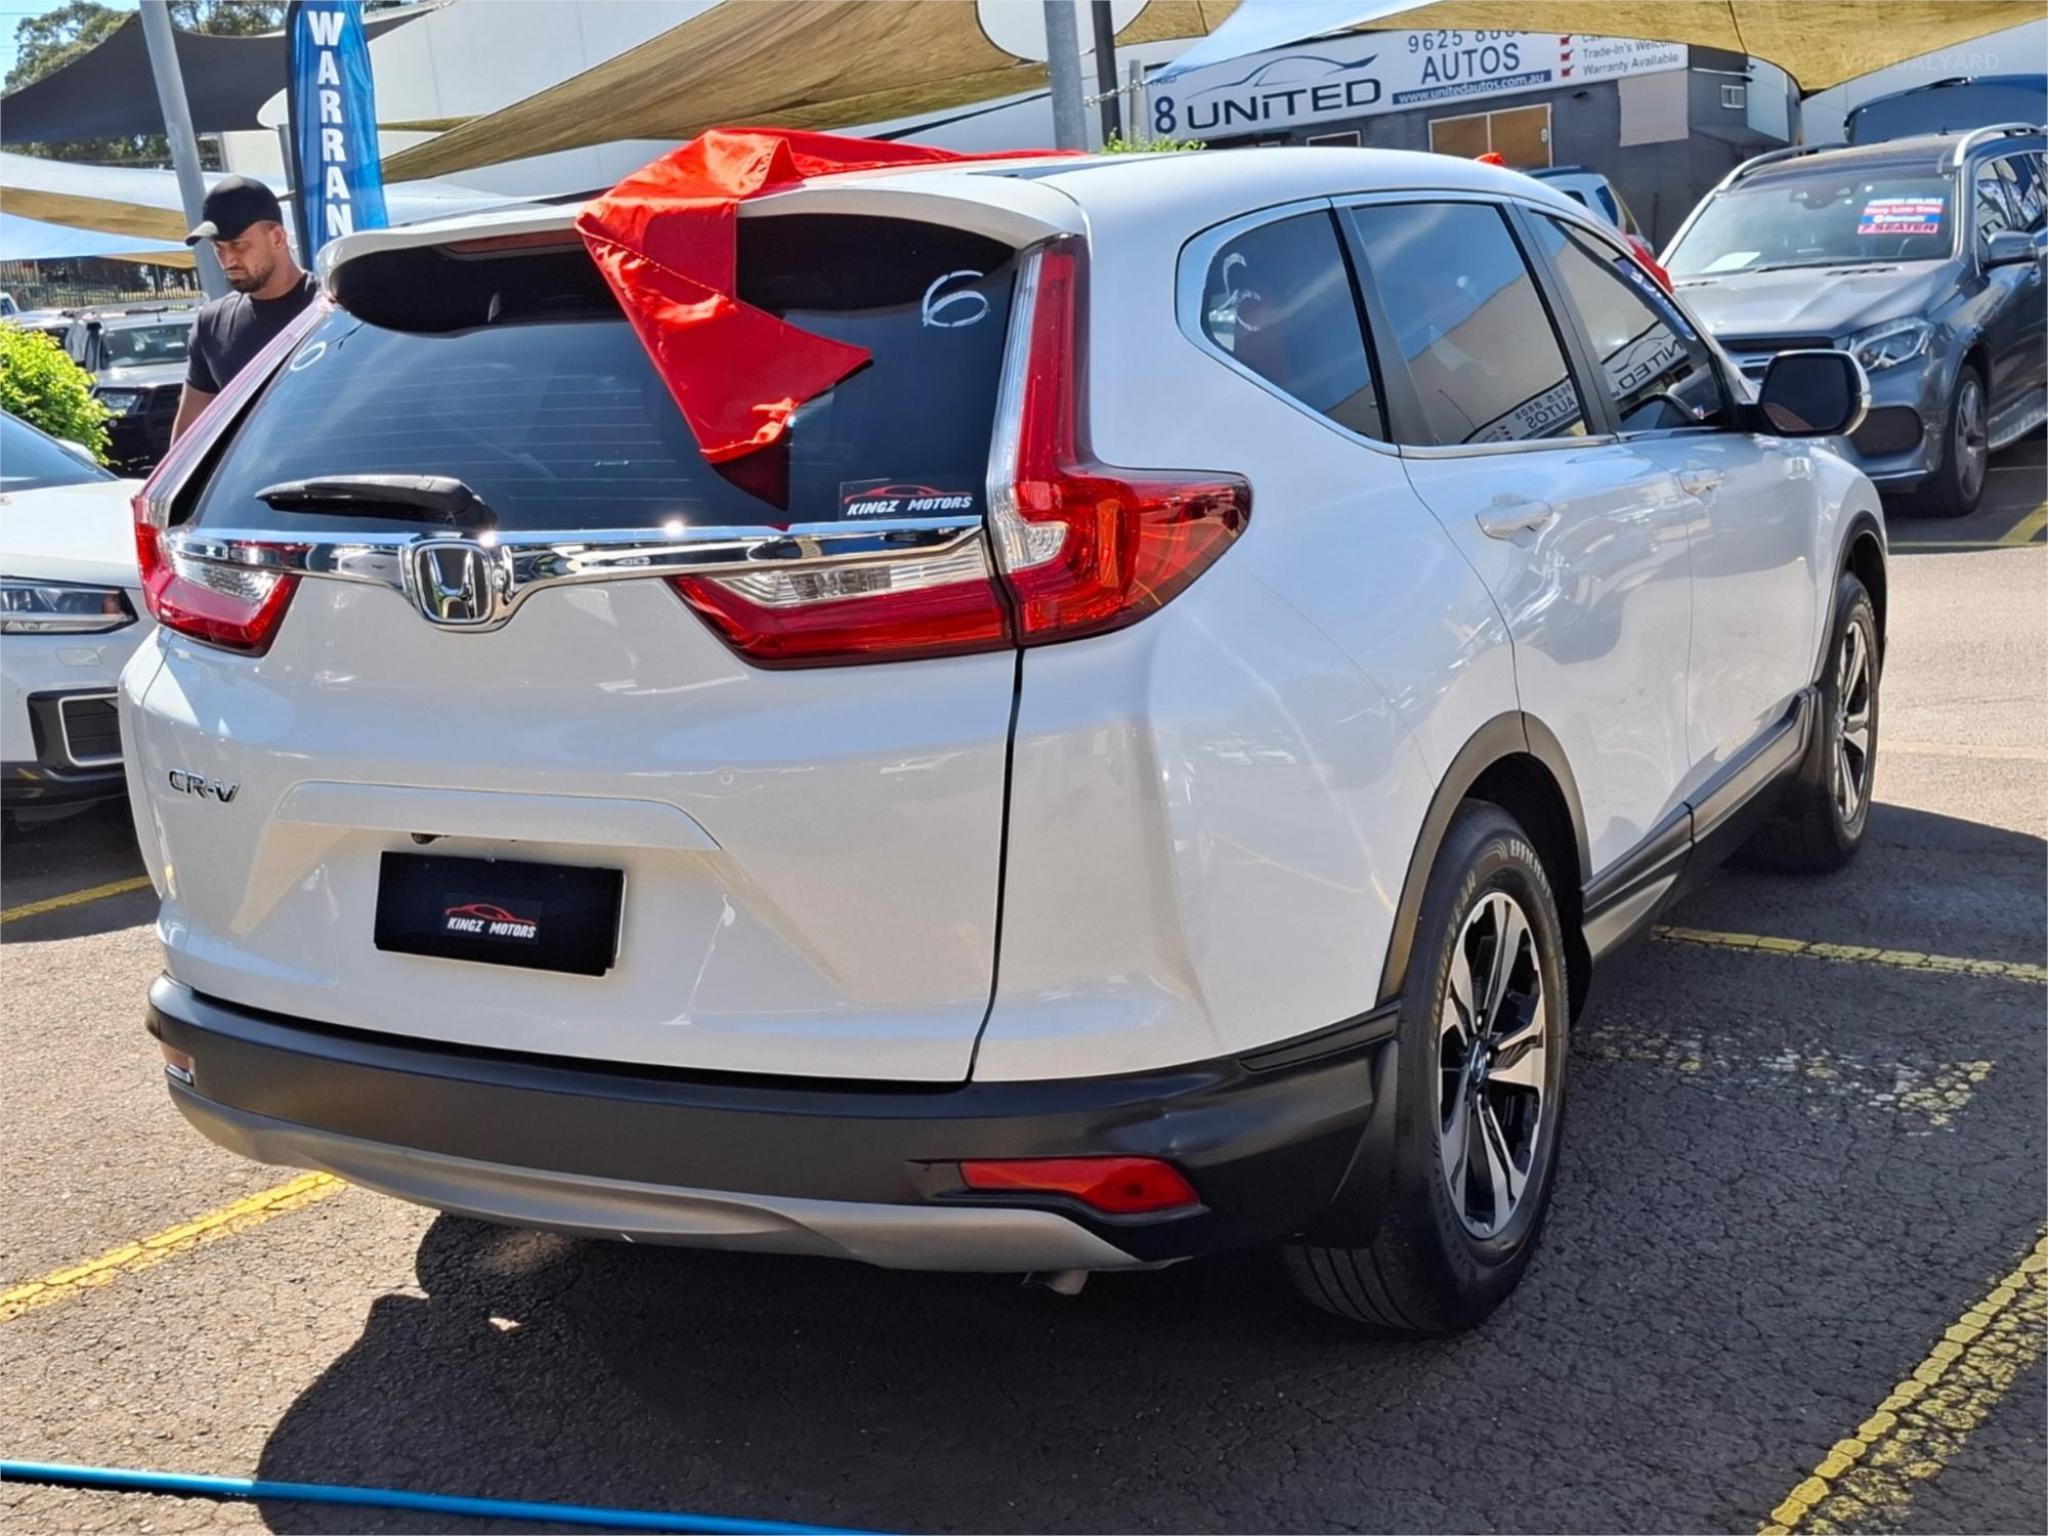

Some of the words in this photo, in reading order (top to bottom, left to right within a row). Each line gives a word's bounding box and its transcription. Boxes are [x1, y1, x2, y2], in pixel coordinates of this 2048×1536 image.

[1408, 30, 1463, 53] 9625
[1421, 42, 1520, 84] AUTOS
[1583, 61, 1629, 75] Warranty
[1632, 53, 1679, 68] Available
[1399, 73, 1545, 103] www.unitedautos.com.au
[1155, 96, 1177, 134] 8
[922, 270, 990, 327] 6
[847, 500, 900, 516] KINGZ
[907, 496, 973, 511] MOTORS
[169, 769, 240, 803] CR-V
[447, 917, 485, 933] KINGZ
[488, 921, 537, 939] MOTORS
